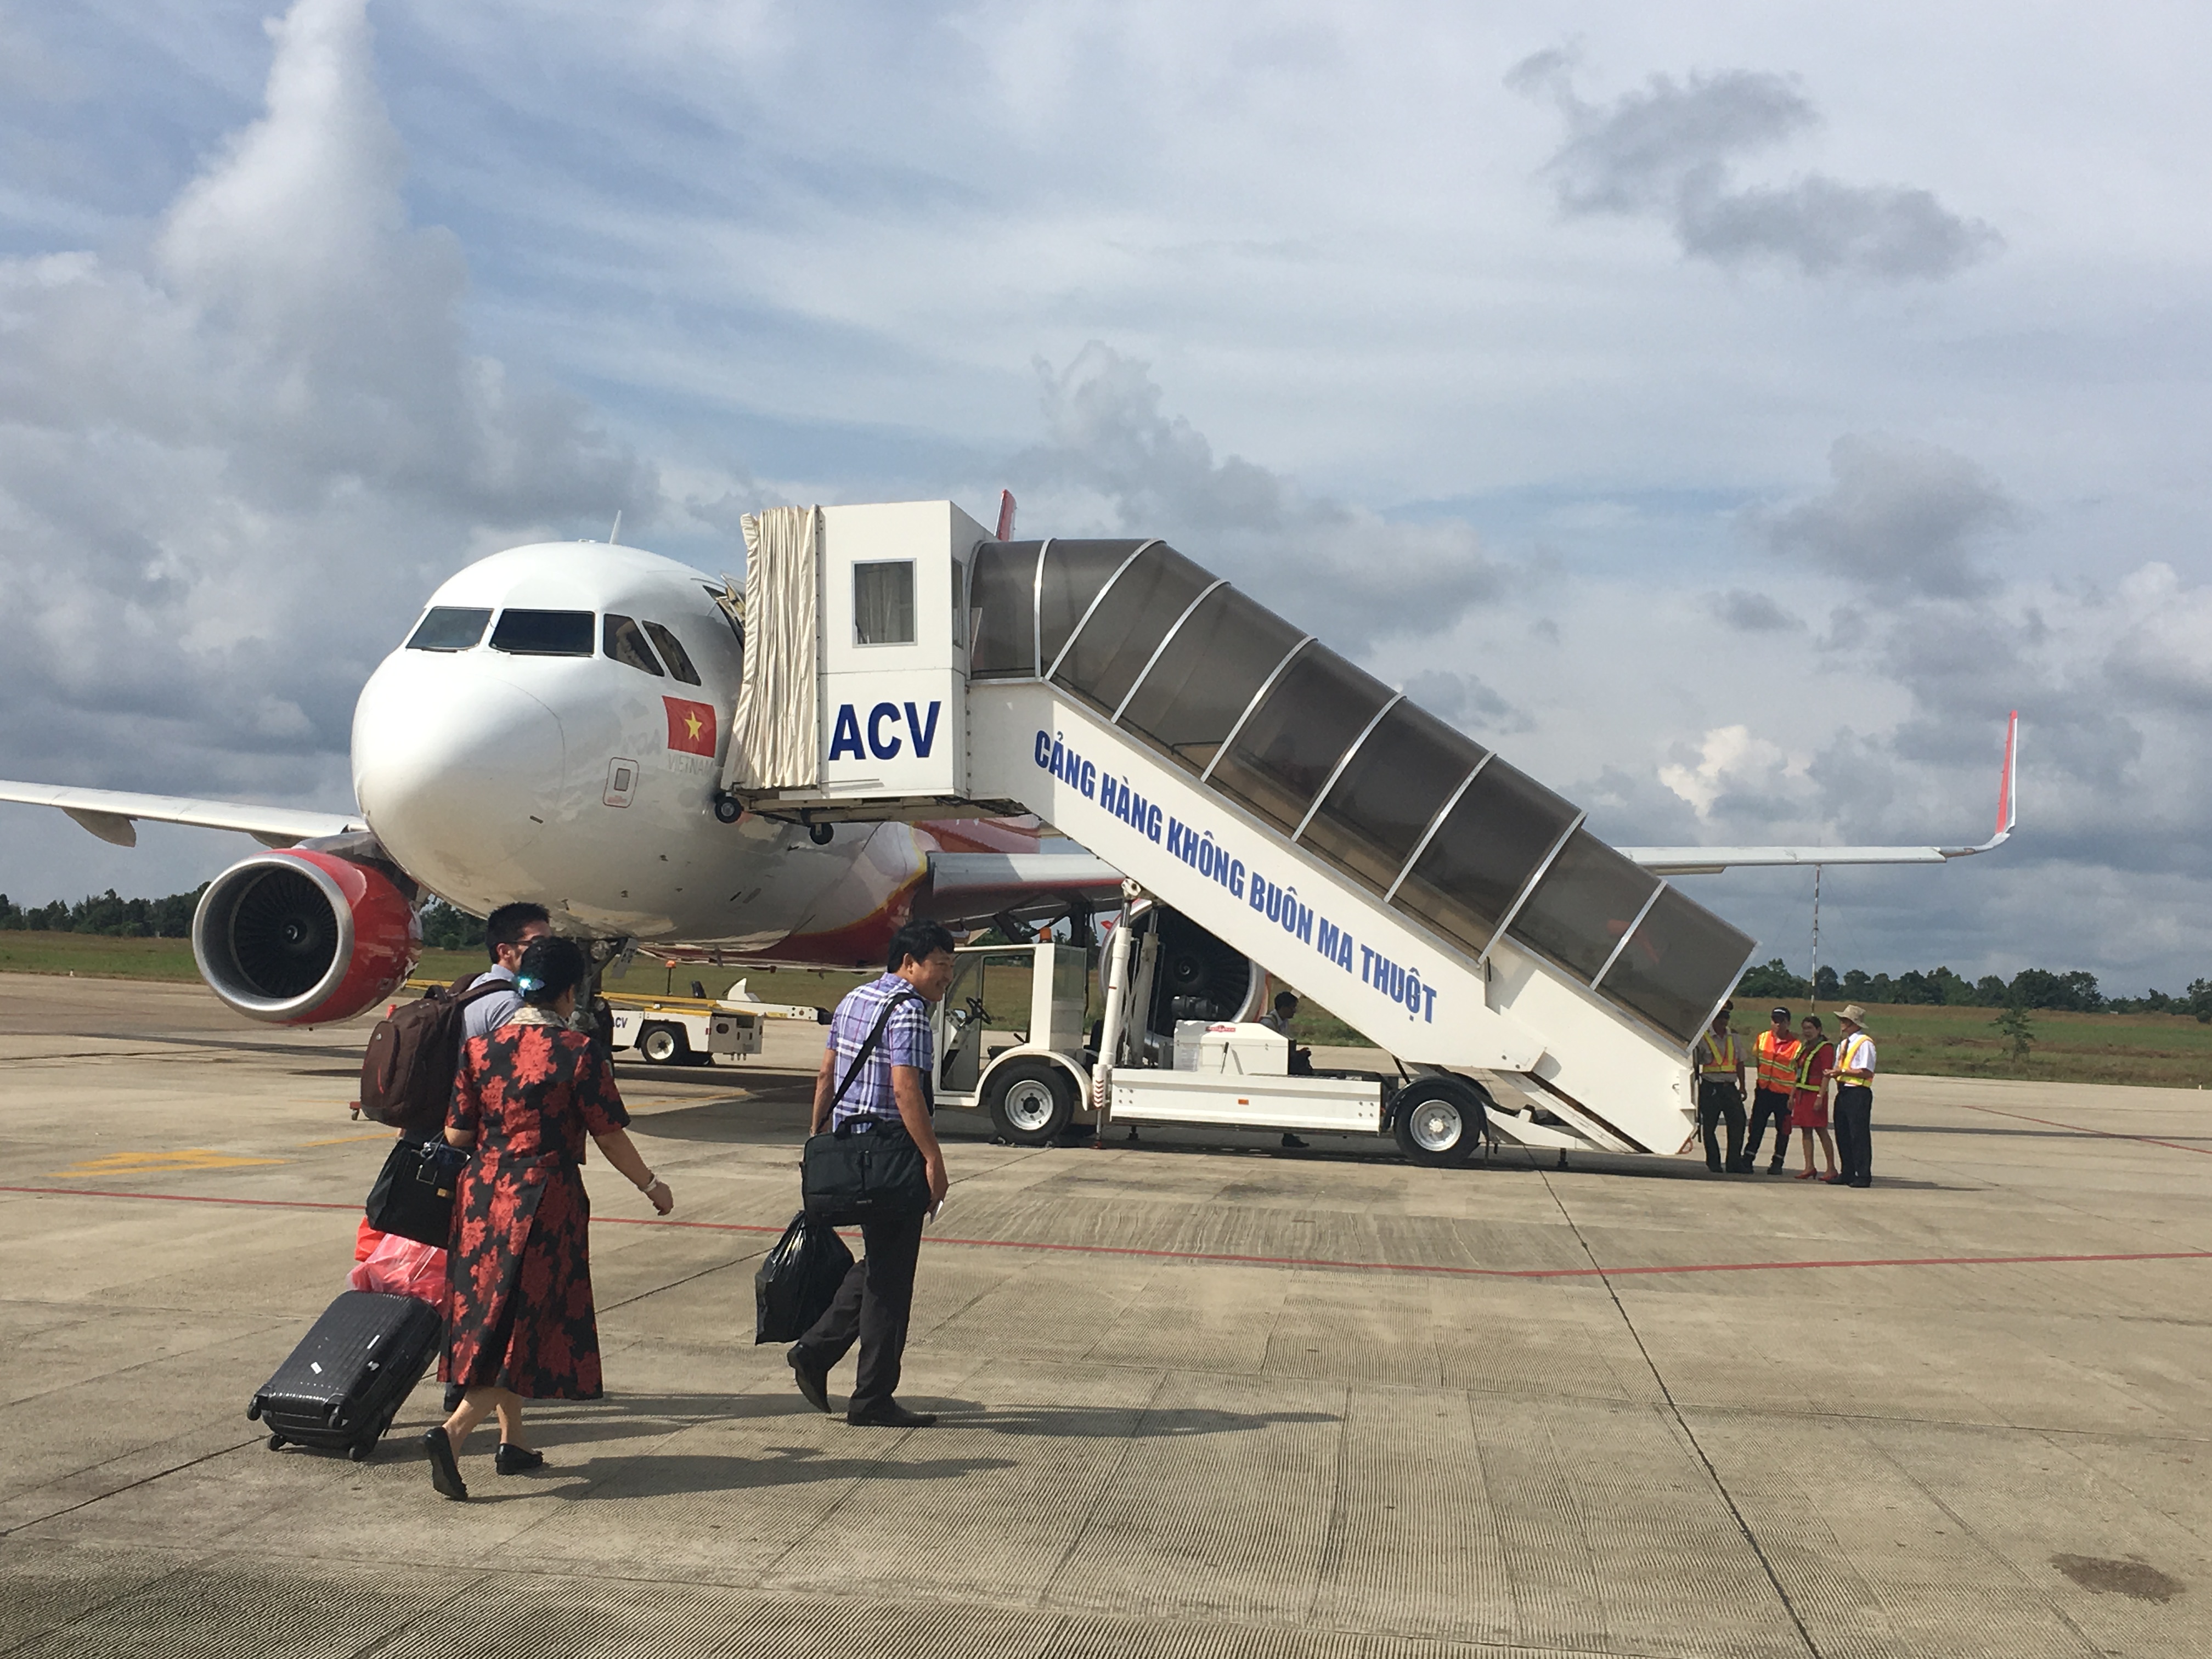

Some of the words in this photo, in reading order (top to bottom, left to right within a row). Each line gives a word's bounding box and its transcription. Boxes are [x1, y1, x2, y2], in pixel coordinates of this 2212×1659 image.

[828, 701, 941, 760] ACV
[1035, 730, 1096, 800] CẢNG
[1100, 772, 1162, 843] HÀNG
[1166, 816, 1245, 899] KHÔNG
[1250, 872, 1313, 944] BUÔN
[1318, 917, 1353, 973] MA
[1361, 944, 1437, 1024] THUỘT
